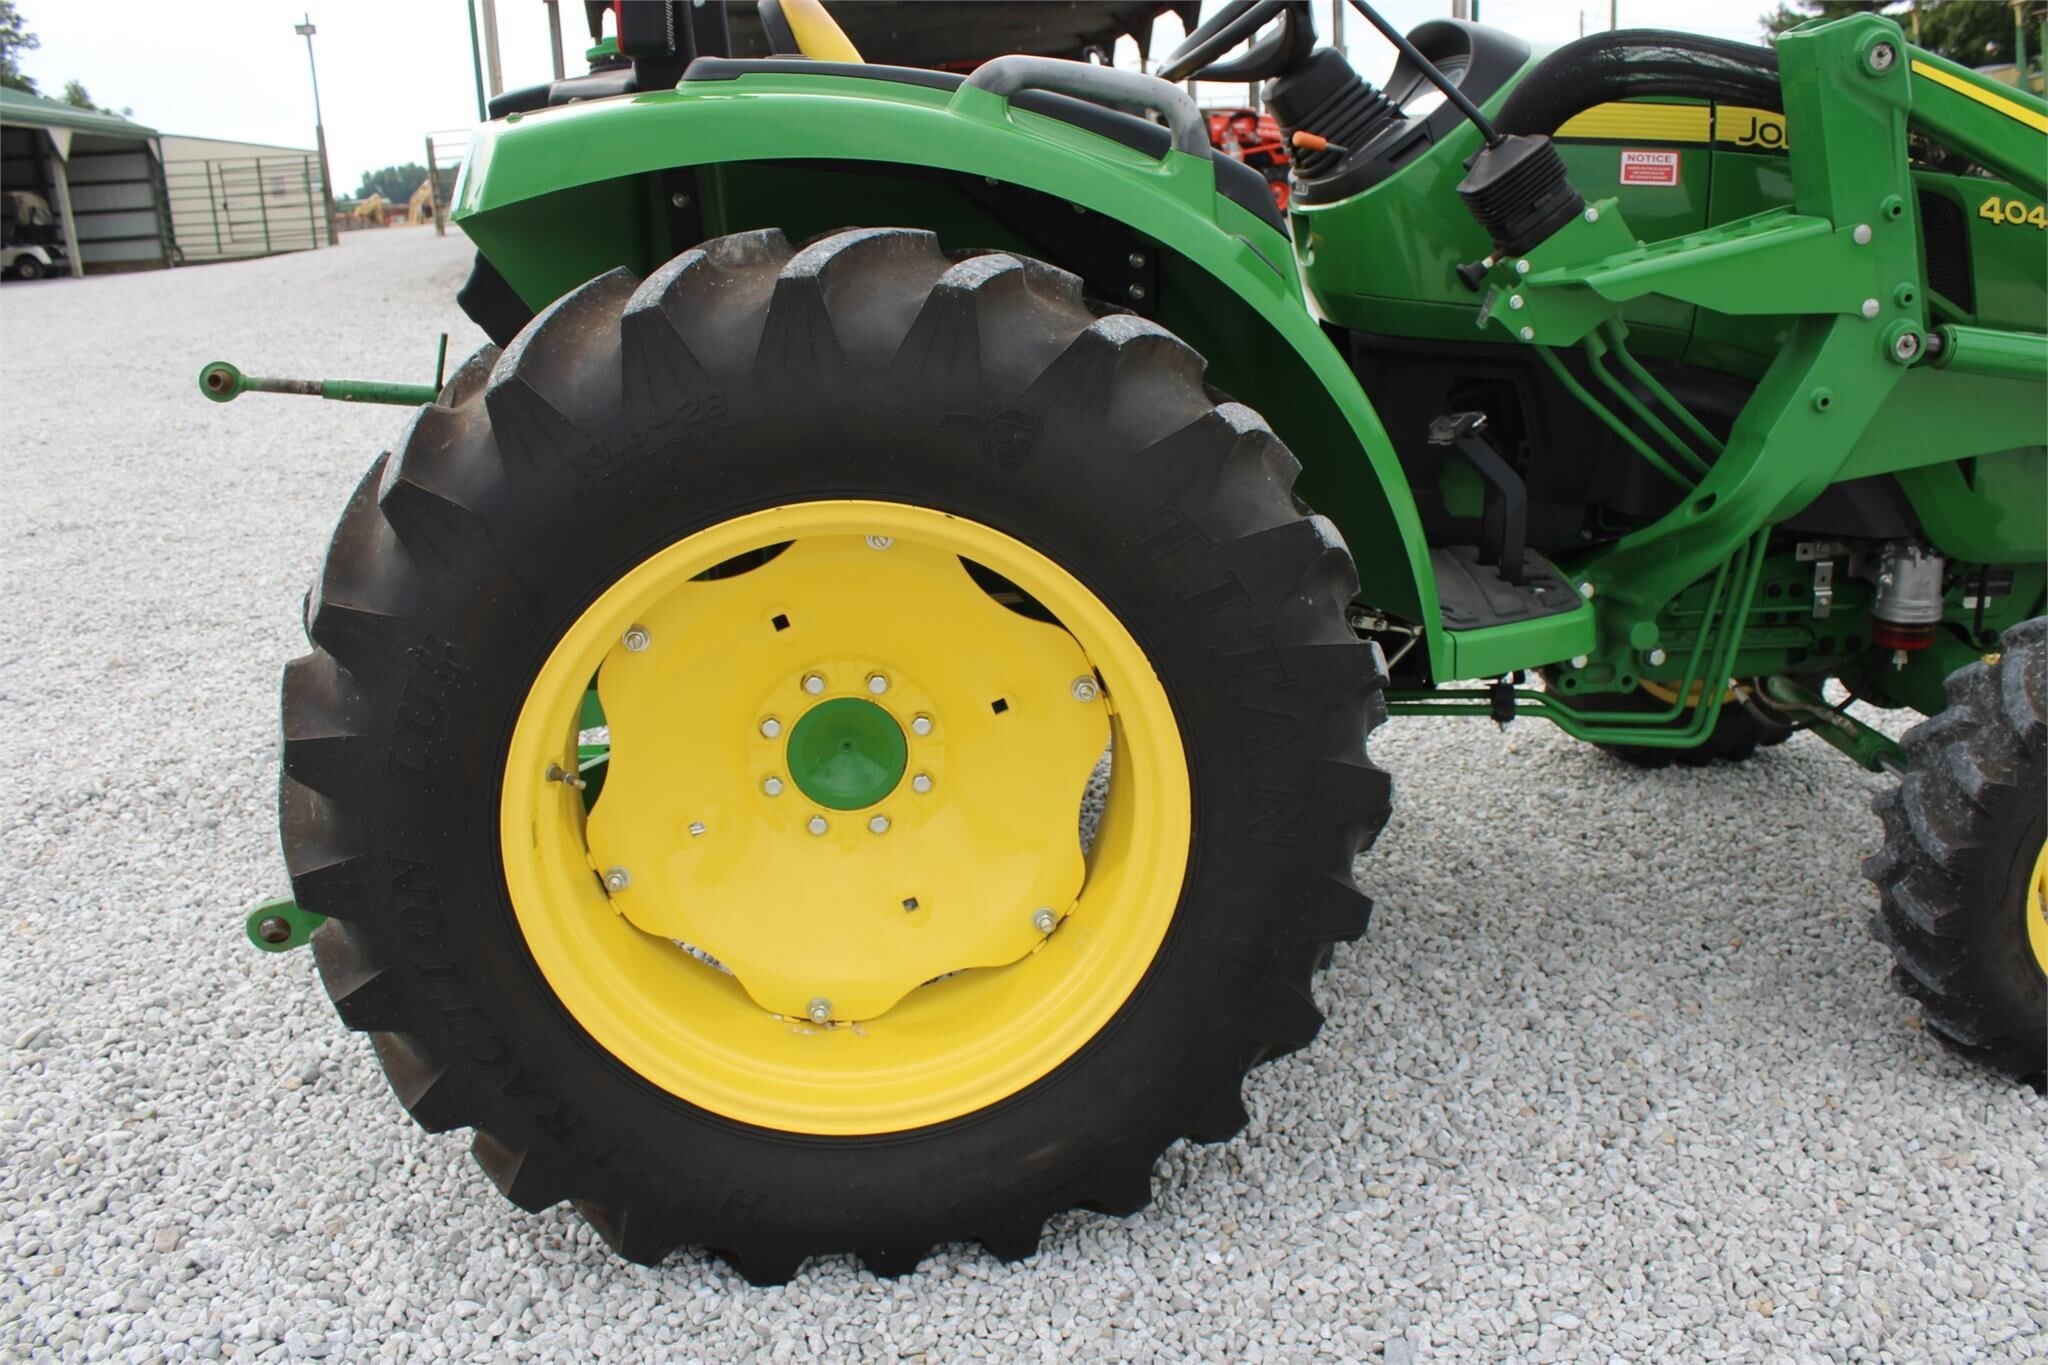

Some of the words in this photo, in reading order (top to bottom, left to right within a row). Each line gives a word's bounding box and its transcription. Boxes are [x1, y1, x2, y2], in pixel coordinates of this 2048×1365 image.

[1738, 115, 1788, 146] JO
[1626, 153, 1673, 163] NOTICE
[1979, 196, 2048, 229] 404
[1118, 494, 1314, 852] TITAN
[384, 634, 465, 792] LUG
